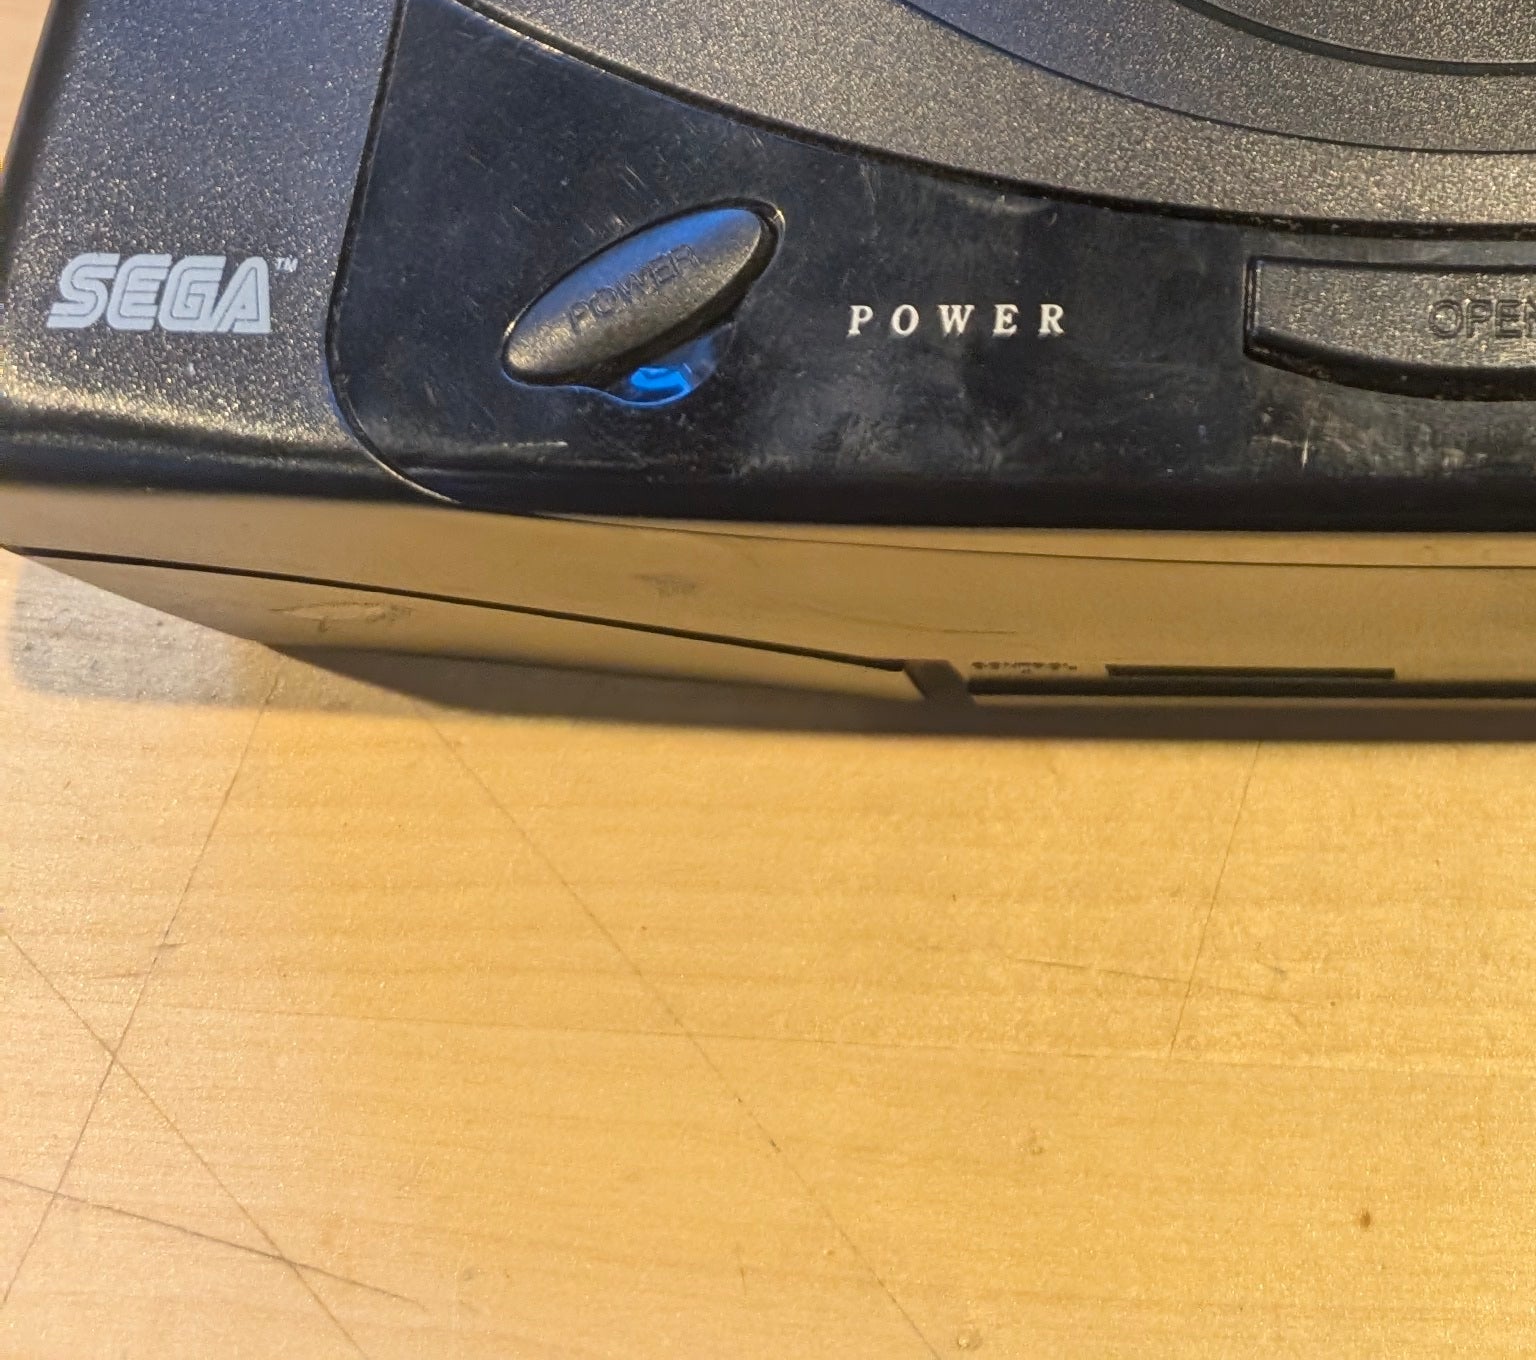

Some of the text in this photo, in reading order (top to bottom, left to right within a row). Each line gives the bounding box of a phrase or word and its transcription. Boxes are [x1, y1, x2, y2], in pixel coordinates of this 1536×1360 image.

[46, 252, 271, 334] SEGA
[567, 243, 701, 335] POWER
[846, 303, 1066, 338] POWER
